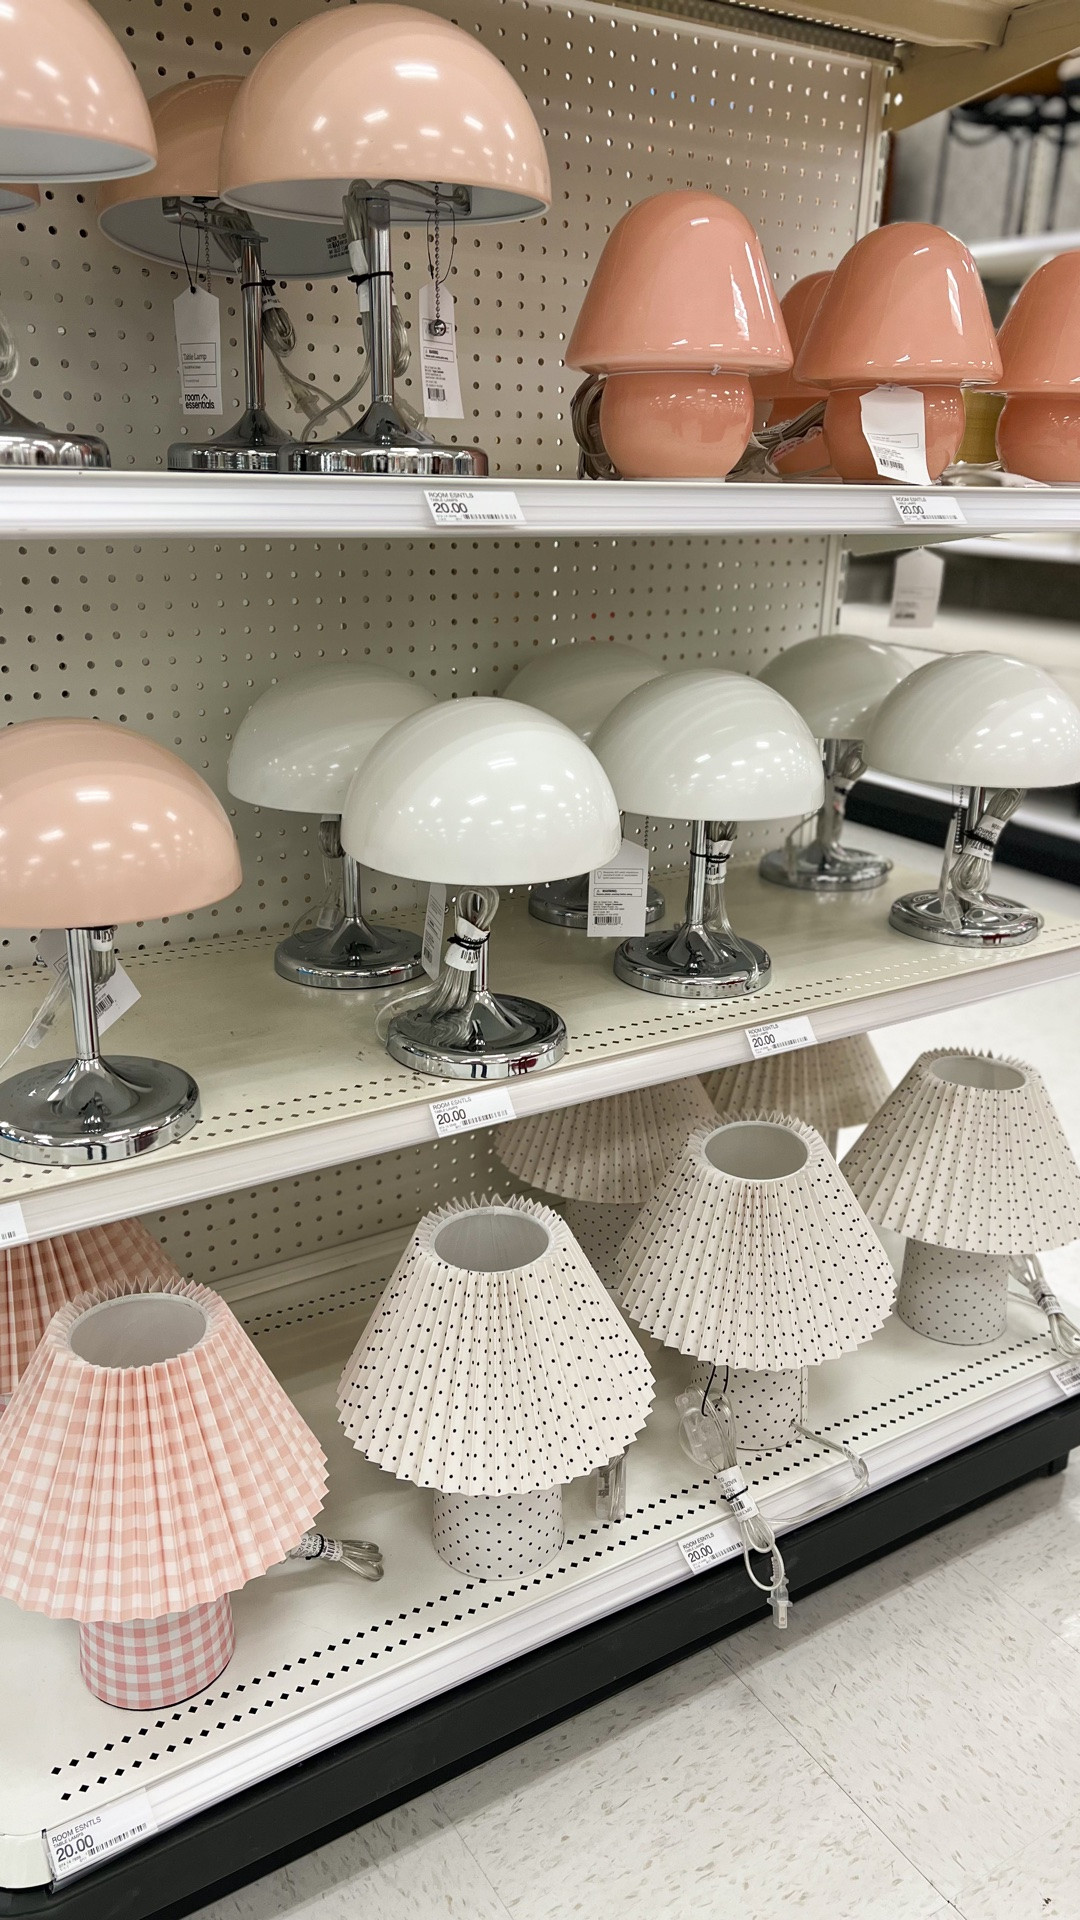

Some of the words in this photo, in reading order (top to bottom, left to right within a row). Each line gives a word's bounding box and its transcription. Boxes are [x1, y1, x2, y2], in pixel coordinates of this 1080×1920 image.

[194, 352, 207, 361] Lamp
[185, 393, 200, 401] room
[185, 400, 215, 409] essentials
[433, 502, 468, 513] 20.00
[900, 505, 925, 514] 20.00
[752, 1034, 776, 1048] 20.00
[433, 1102, 450, 1110] ROOM
[451, 1097, 472, 1106] ESNTLS
[436, 1108, 467, 1125] 20.00
[682, 1540, 697, 1550] ROOM
[697, 1532, 715, 1544] ESNTLS
[687, 1544, 714, 1563] 20.00
[51, 1829, 74, 1844] ROOM
[74, 1816, 102, 1833] ESNTLS
[53, 1839, 69, 1849] TABLE
[68, 1832, 84, 1842] LAMPS
[56, 1834, 94, 1862] 20.00
